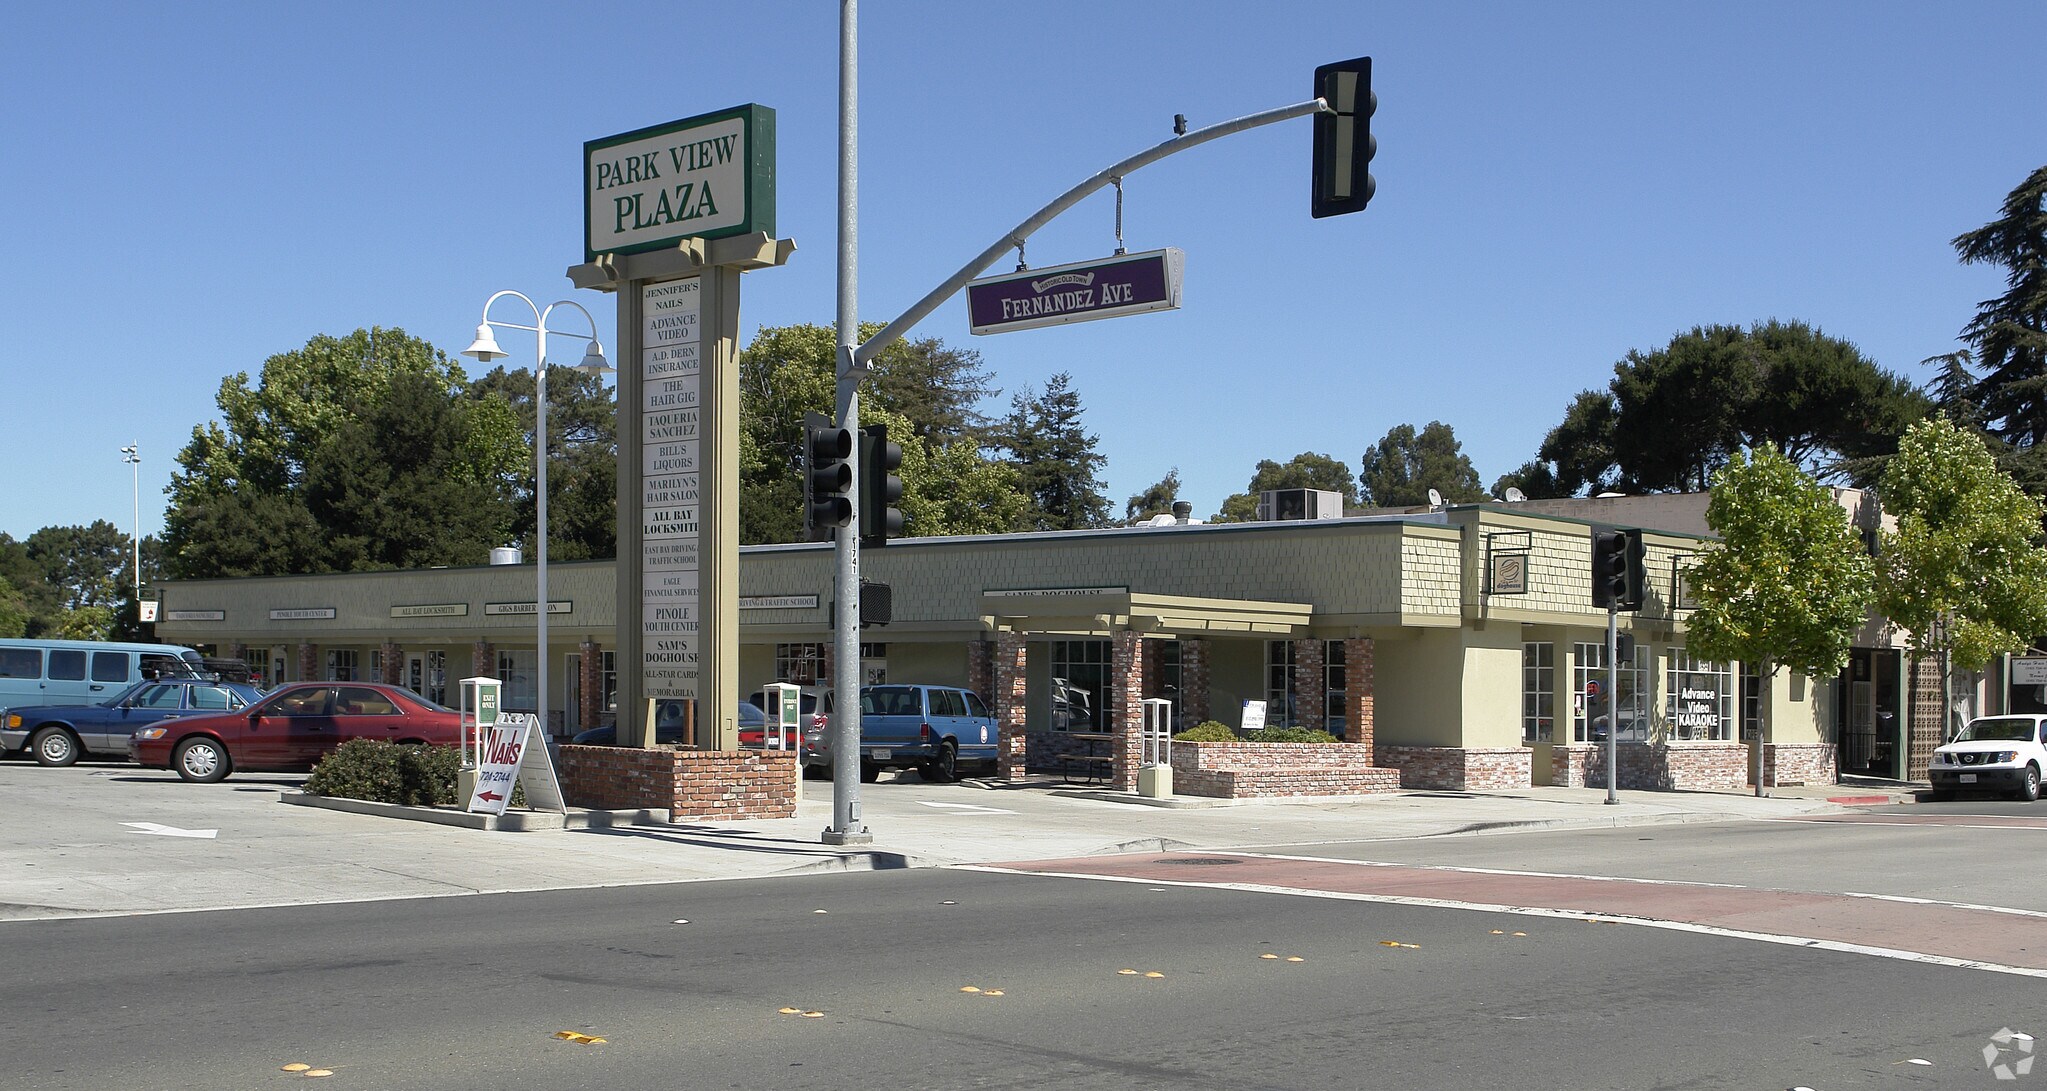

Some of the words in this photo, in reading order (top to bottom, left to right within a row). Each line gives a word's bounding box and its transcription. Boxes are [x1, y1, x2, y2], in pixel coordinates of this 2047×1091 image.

[596, 151, 661, 191] PARK
[668, 133, 738, 174] VIEW
[613, 180, 719, 234] PLAZA
[1039, 277, 1061, 290] HISTORIC
[1073, 275, 1088, 284] TOWN
[645, 282, 699, 298] JENNIFER'S
[655, 299, 683, 310] NAILS
[1001, 289, 1095, 320] FERNANDEZ
[1100, 282, 1134, 306] AVE
[650, 314, 696, 330] ADVANCE
[657, 328, 688, 341] VIDEO
[652, 351, 669, 361] A.D.
[671, 347, 695, 359] DERN
[648, 359, 699, 374] INSURANCE
[663, 380, 683, 392] THE
[651, 394, 675, 406] HAIR
[677, 392, 695, 404] GIG
[648, 412, 697, 427] TAQUERIA
[649, 425, 696, 439] SANCHEZ
[659, 445, 687, 457] BILL'S
[653, 457, 693, 471] LIQUORS
[649, 477, 697, 490] MARILYN'S
[647, 492, 669, 503] HAIR
[670, 490, 698, 501] SALON
[652, 511, 671, 522] ALL
[673, 510, 693, 520] BAY
[644, 546, 659, 555] EAST
[660, 545, 671, 554] BAY
[671, 544, 696, 553] DRIVING
[649, 557, 673, 565] TRAFFIC
[673, 556, 696, 564] SCHOOL
[663, 577, 681, 586] EAGLE
[644, 589, 673, 598] FINANCIAL
[789, 598, 815, 606] SCHOOL
[423, 606, 455, 615] LOCKSMITH
[655, 607, 689, 620] PINOLE
[645, 622, 670, 632] YOUTH
[657, 640, 687, 651] SAM'S
[644, 670, 676, 679] ALL-STAR
[482, 694, 495, 702] EXIT
[647, 688, 694, 697] MEMORABILIA
[1681, 687, 1715, 700] Advance
[482, 701, 496, 709] ONLY
[1687, 701, 1710, 713] Video
[1678, 714, 1718, 726] KARAOKE
[481, 771, 511, 782] 724-2744
